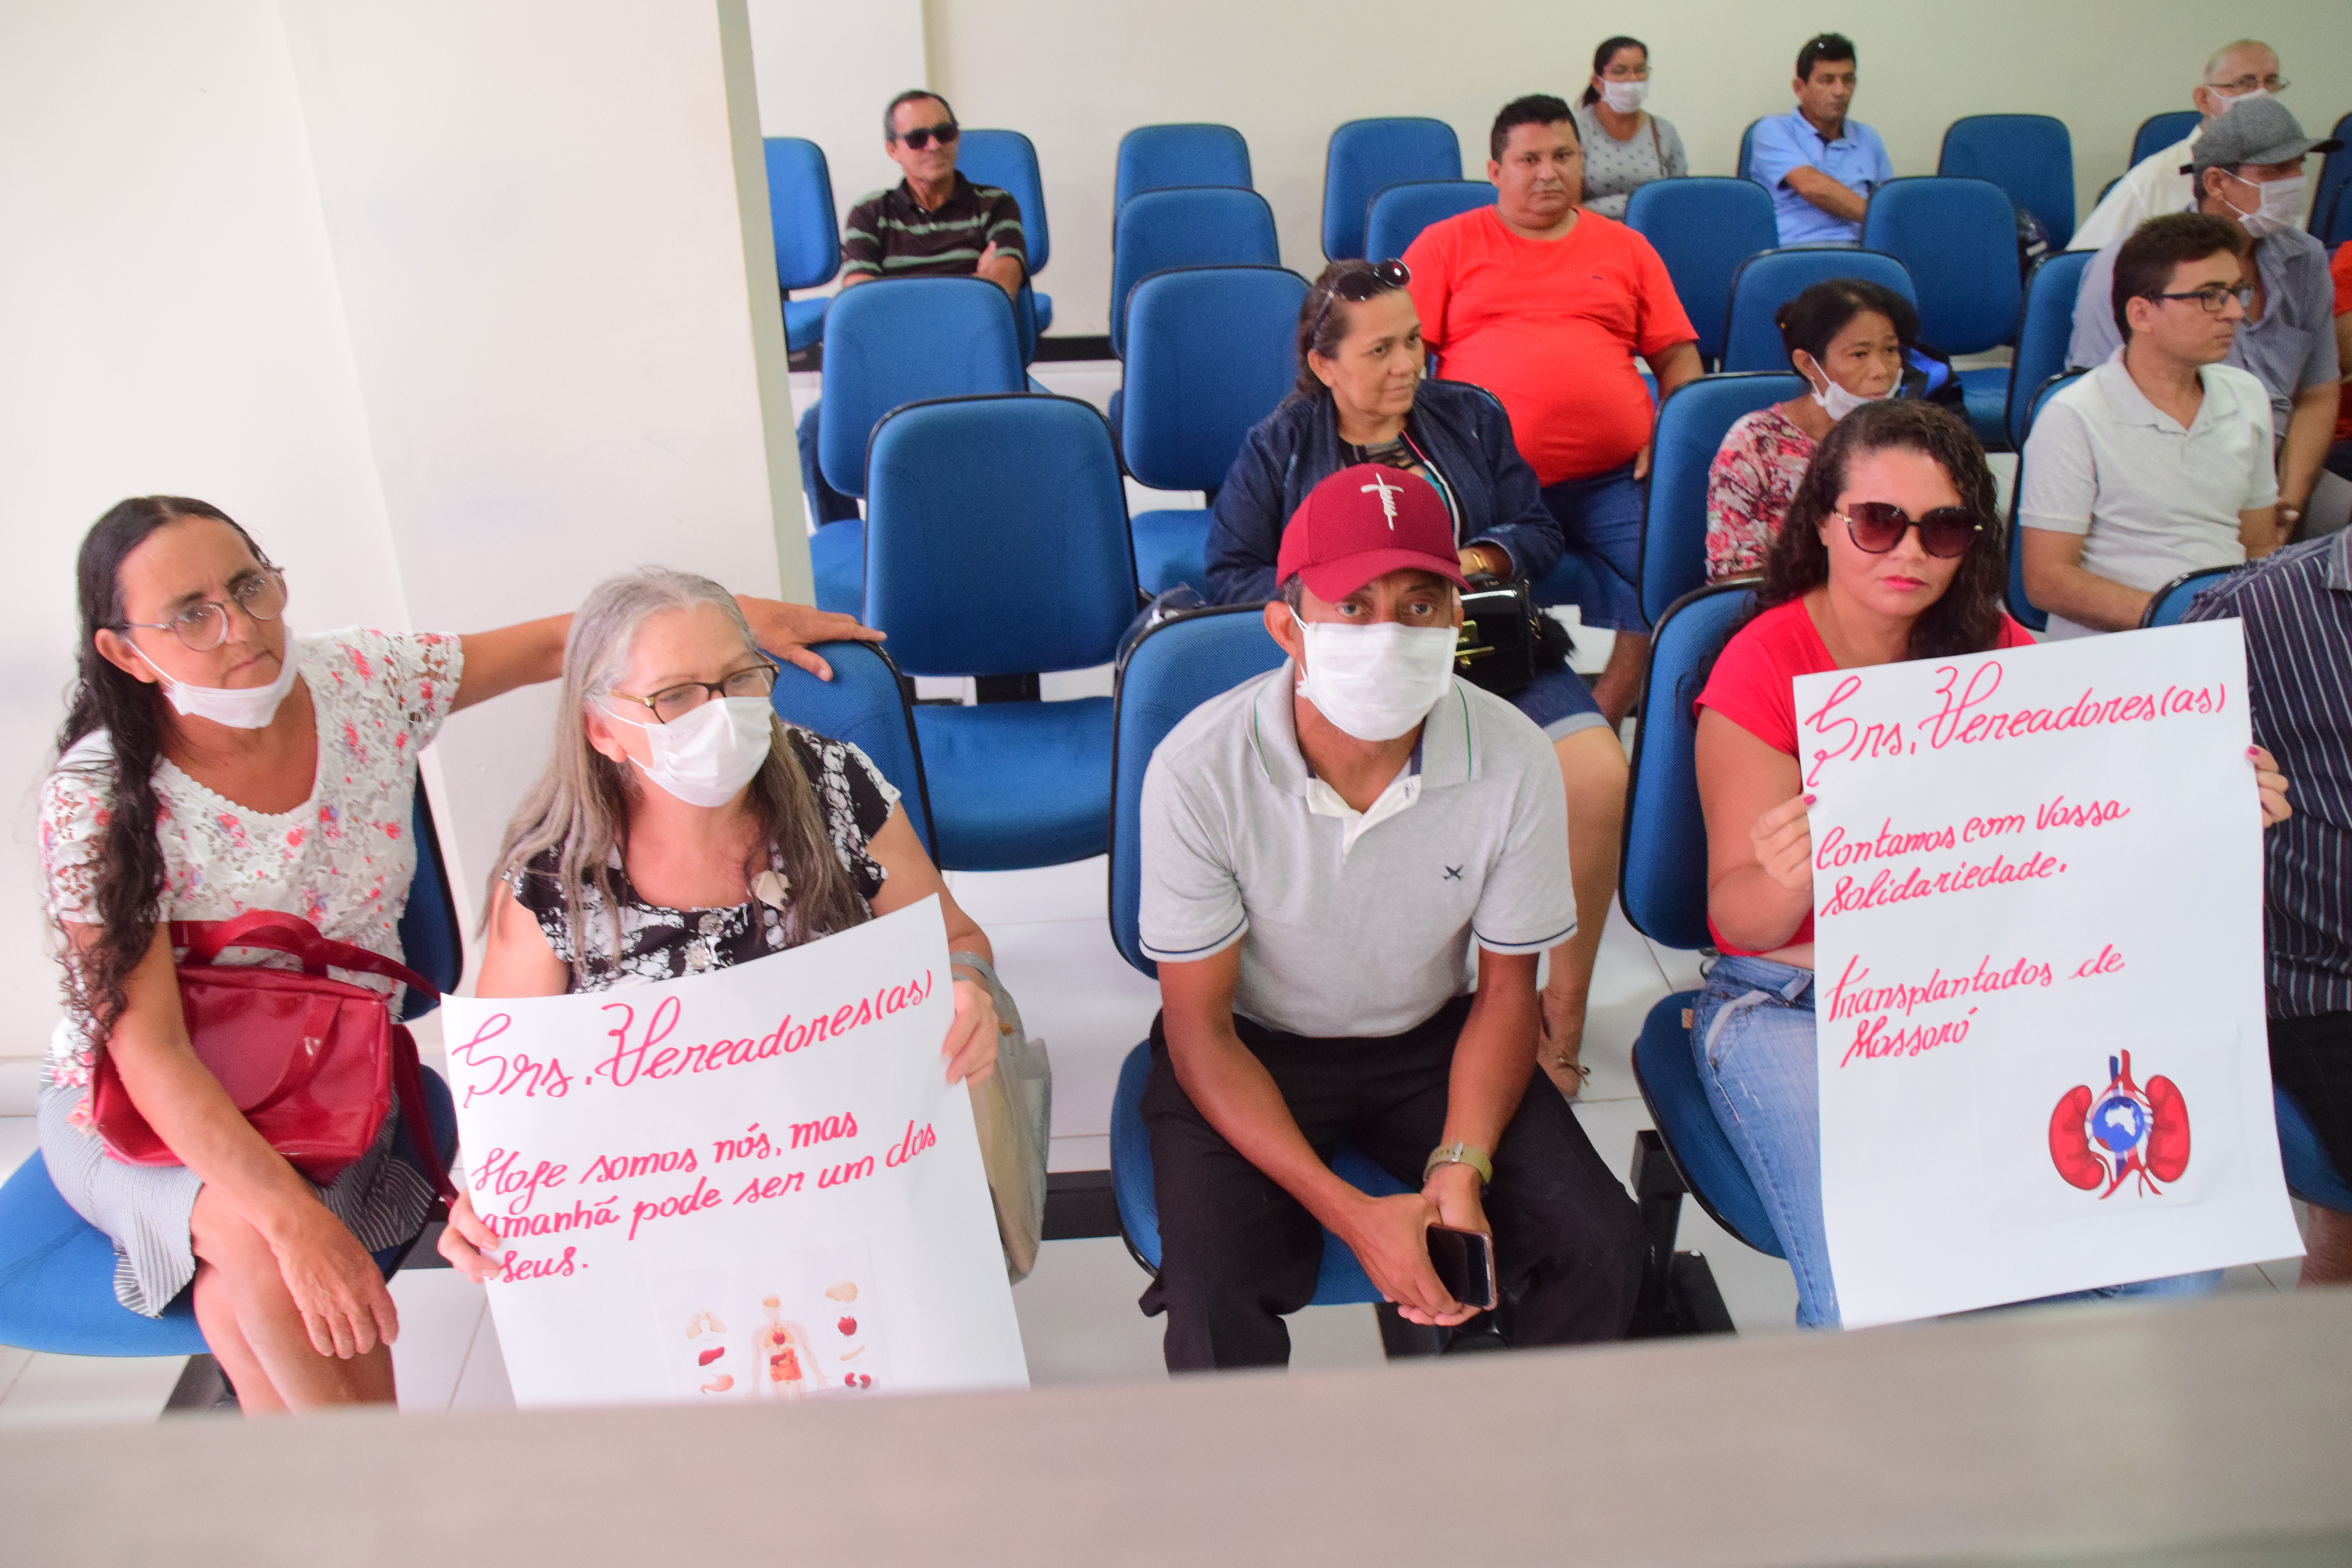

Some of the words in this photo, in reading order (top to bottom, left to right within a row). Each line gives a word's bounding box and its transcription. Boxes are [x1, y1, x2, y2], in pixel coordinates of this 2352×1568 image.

[1918, 661, 2226, 750] Vereadores(as)
[1815, 817, 1956, 870] Contamos
[1962, 814, 2026, 843] com
[2068, 943, 2125, 978] de
[594, 969, 932, 1087] Vereadores(as)
[1840, 1006, 1978, 1069] Mossoró
[470, 1147, 568, 1216] Hoje
[578, 1147, 699, 1185] somos
[711, 1122, 782, 1164] nós,
[787, 1111, 859, 1150] mas
[482, 1194, 621, 1239] amanhã
[627, 1175, 723, 1241] pode
[732, 1171, 805, 1205] ser
[817, 1155, 875, 1189] um
[884, 1119, 937, 1168] dos
